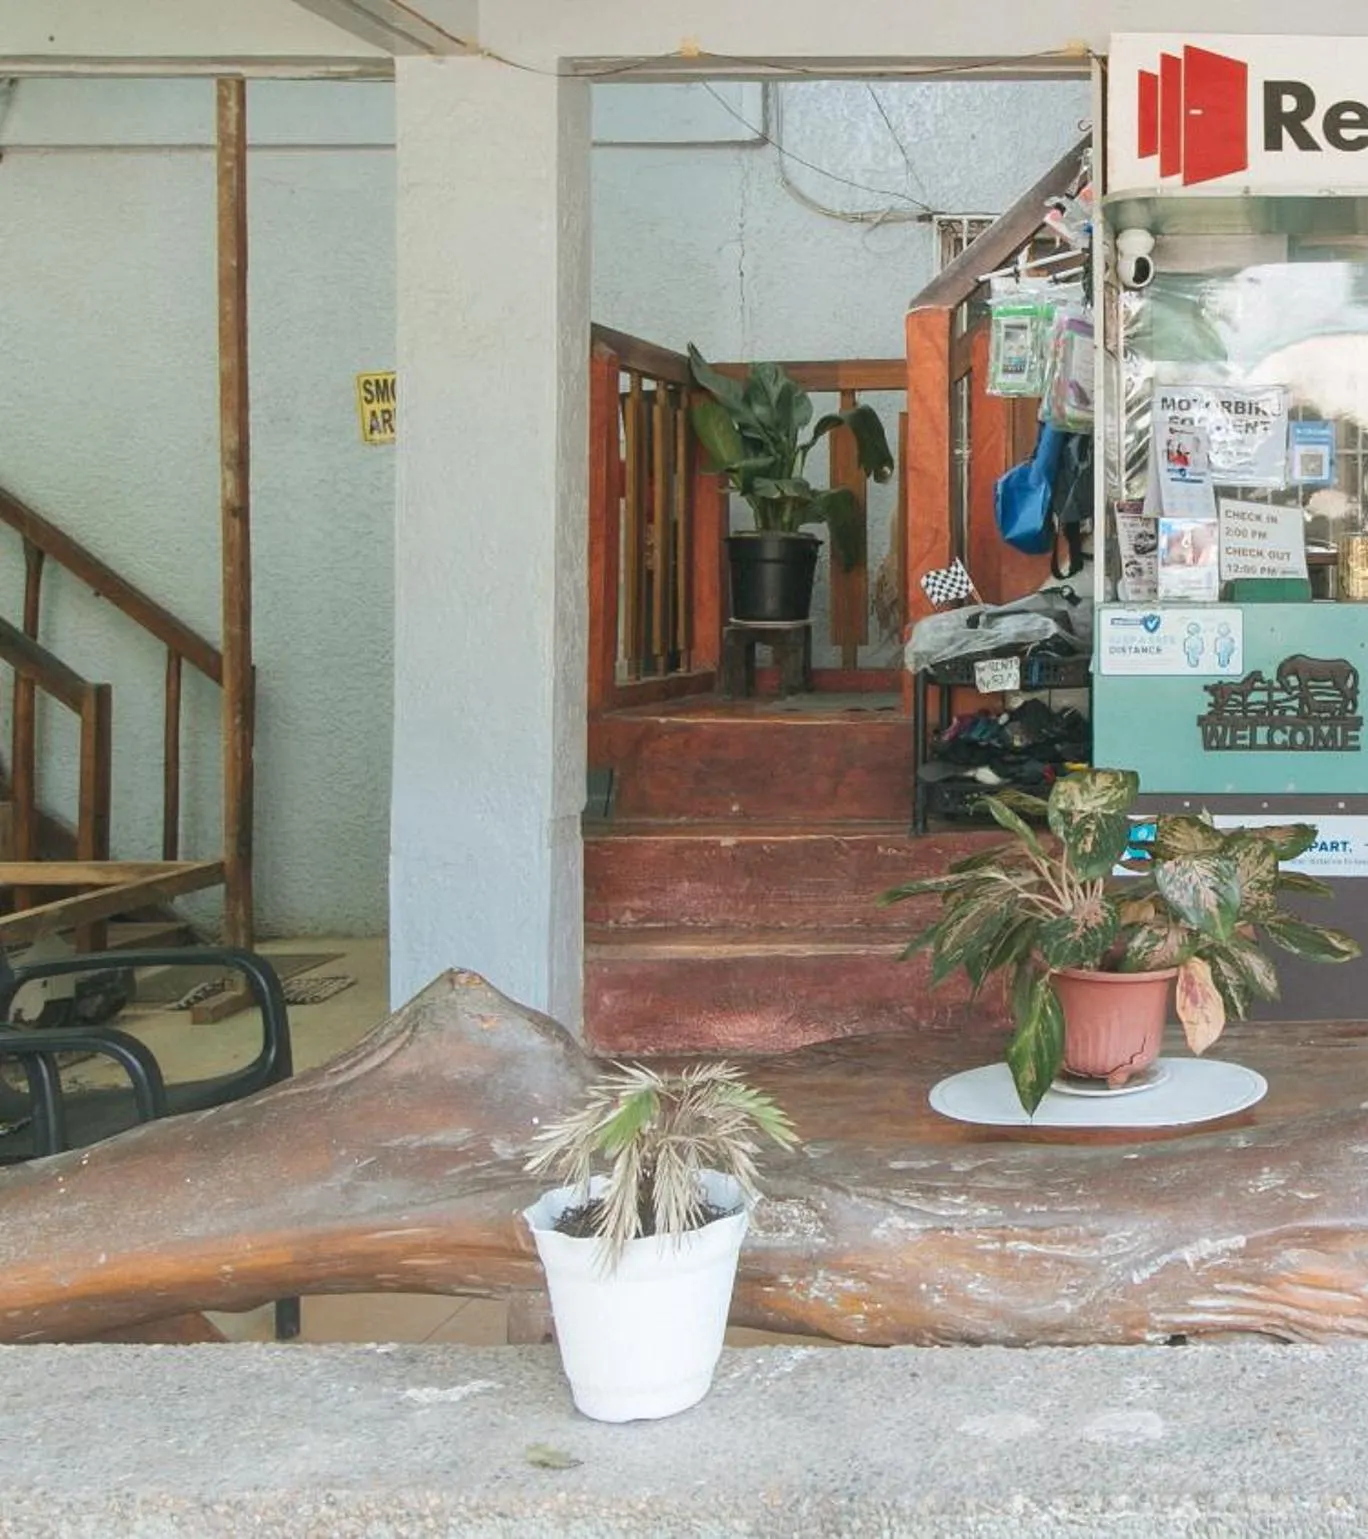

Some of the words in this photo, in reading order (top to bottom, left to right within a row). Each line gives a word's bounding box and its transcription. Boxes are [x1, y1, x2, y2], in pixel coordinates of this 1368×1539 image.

[370, 408, 396, 435] AR
[1225, 509, 1262, 522] CHECK
[1265, 515, 1278, 524] IN
[1251, 529, 1267, 540] PM
[1225, 546, 1263, 558] CHECK
[1267, 550, 1291, 561] OUT
[1225, 563, 1258, 575] 12:00
[1260, 566, 1277, 577] PM
[1109, 646, 1163, 655] DISTANCE
[1202, 723, 1362, 752] WELCOME
[1306, 840, 1353, 853] PART,
